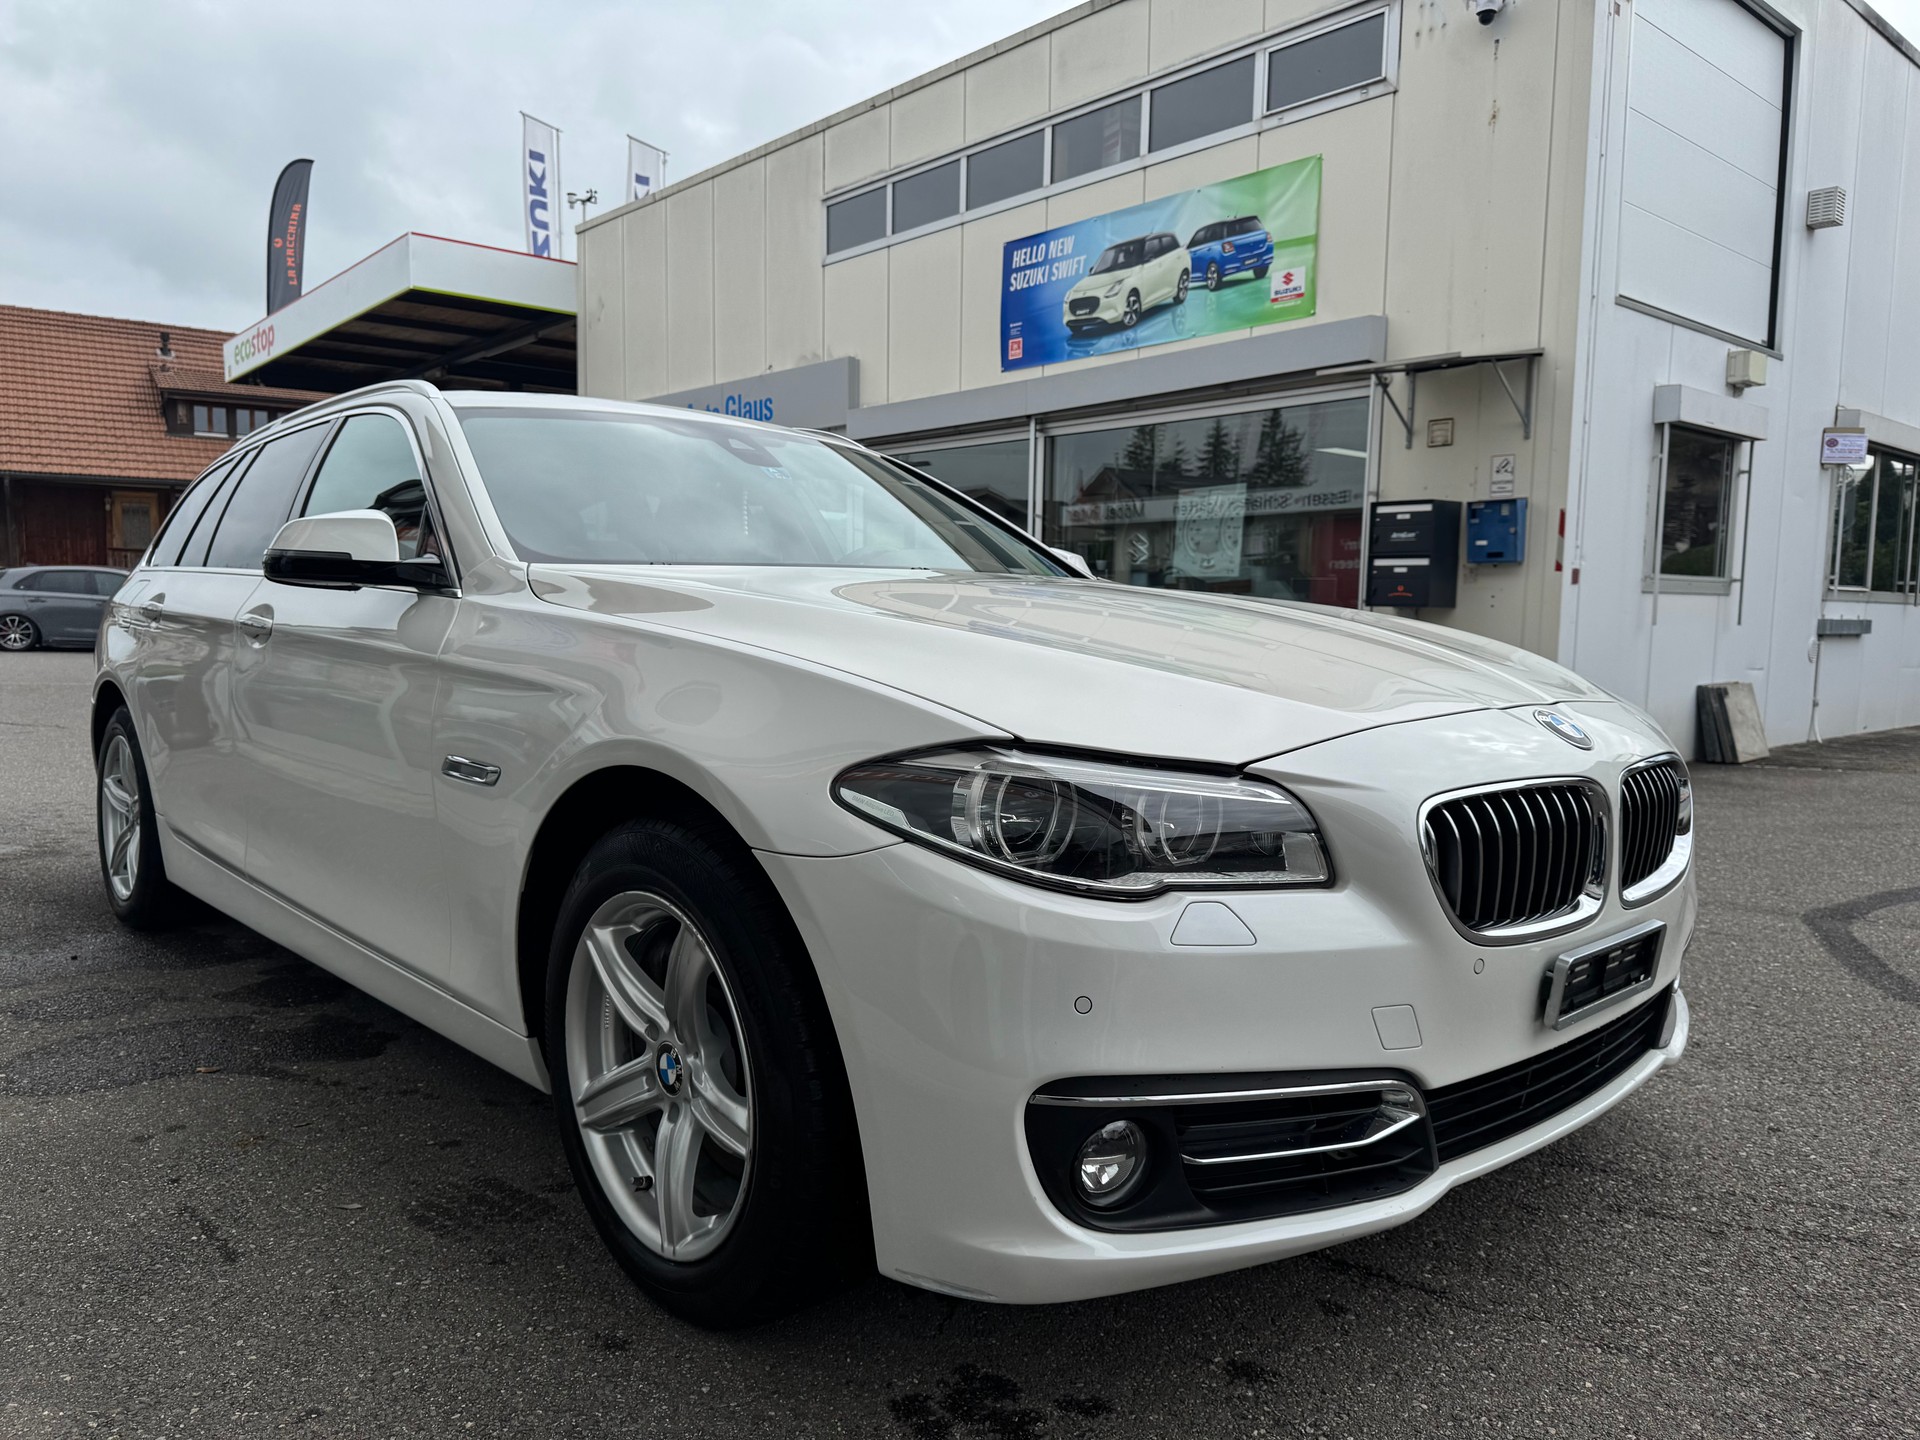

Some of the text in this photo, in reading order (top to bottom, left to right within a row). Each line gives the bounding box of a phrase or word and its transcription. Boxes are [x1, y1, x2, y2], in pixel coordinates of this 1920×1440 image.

[286, 203, 302, 267] MACCHINA
[1012, 235, 1075, 269] HELLO NEW
[288, 269, 298, 285] LA
[1009, 255, 1087, 292] SUZUKI SWIFT
[234, 324, 275, 366] ecostop
